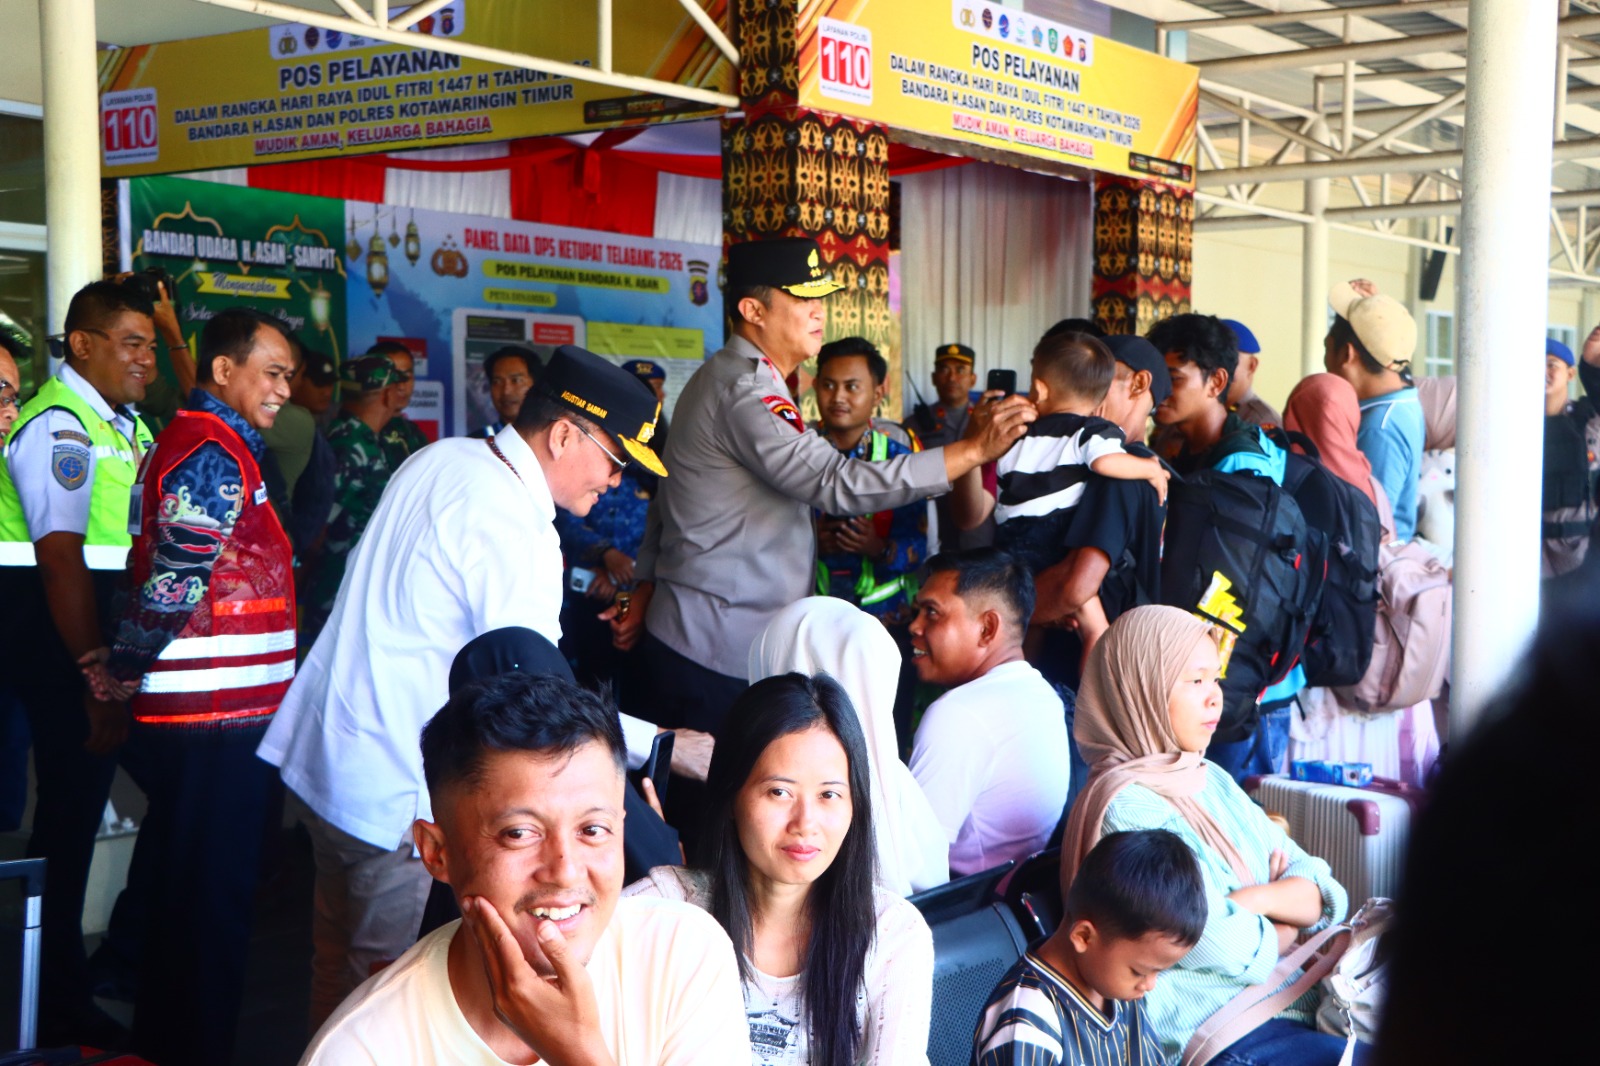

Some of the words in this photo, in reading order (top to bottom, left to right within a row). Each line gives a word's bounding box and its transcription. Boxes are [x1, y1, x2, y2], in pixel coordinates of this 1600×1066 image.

[280, 64, 321, 90] POS
[328, 51, 460, 84] PELAYANAN
[822, 40, 870, 89] 110
[972, 44, 1000, 71] POS
[1004, 52, 1080, 92] PELAYANAN
[175, 106, 217, 124] DALAM
[222, 99, 277, 118] RANGKA
[281, 95, 313, 111] HARI
[317, 89, 353, 107] RAYA
[357, 85, 391, 102] IDUL
[395, 80, 433, 98] FITRI
[438, 76, 473, 93] 1447
[478, 74, 489, 89] H
[493, 68, 548, 87] TAHUN
[891, 54, 926, 76] DALAM
[929, 64, 969, 87] RANGKA
[972, 74, 994, 93] HARI
[997, 81, 1019, 99] RAYA
[1021, 88, 1042, 106] IDUL
[1044, 93, 1065, 112] FITRI
[1067, 100, 1086, 117] 1447
[1087, 105, 1094, 117] H
[1096, 107, 1122, 126] TAHUN
[107, 107, 156, 149] 110
[189, 122, 249, 141] BANDARA
[253, 116, 303, 133] H.ASAN
[307, 112, 335, 128] DAN
[339, 105, 394, 124] POLRES
[399, 92, 517, 118] KOTAWARINGIN
[522, 84, 574, 104] TIMUR
[901, 79, 949, 103] BANDARA
[952, 92, 987, 114] H.ASAN
[989, 100, 1007, 118] DAN
[1010, 105, 1043, 125] POLRES
[1045, 114, 1107, 140] KOTAWARINGIN
[1109, 129, 1133, 147] TIMUR
[254, 136, 297, 155] MUDIK
[301, 131, 344, 150] AMAN,
[347, 123, 422, 146] KELUARGA
[426, 116, 493, 136] BAHAGIA
[952, 113, 982, 135] MUDIK
[985, 121, 1013, 143] AMAN,
[1014, 126, 1057, 149] KELUARGA
[1060, 135, 1095, 158] BAHAGIA
[143, 229, 195, 257] BANDAR
[197, 235, 239, 261] UDARA
[242, 240, 255, 262] H.
[256, 241, 286, 265] ASAN
[294, 245, 336, 270] SAMPIT
[464, 228, 501, 252] PANEL
[504, 232, 532, 255] DATA
[534, 236, 556, 258] OPS
[559, 239, 603, 262] KETUPAT
[607, 245, 656, 269] TELABANG
[212, 271, 277, 298] Mengucapkan
[496, 263, 517, 276] POS
[519, 264, 576, 281] PELAYANAN
[578, 271, 622, 287] BANDARA
[635, 276, 660, 290] ASAN
[561, 390, 586, 409] AGUSTIAR
[586, 403, 608, 419] SABRAN
